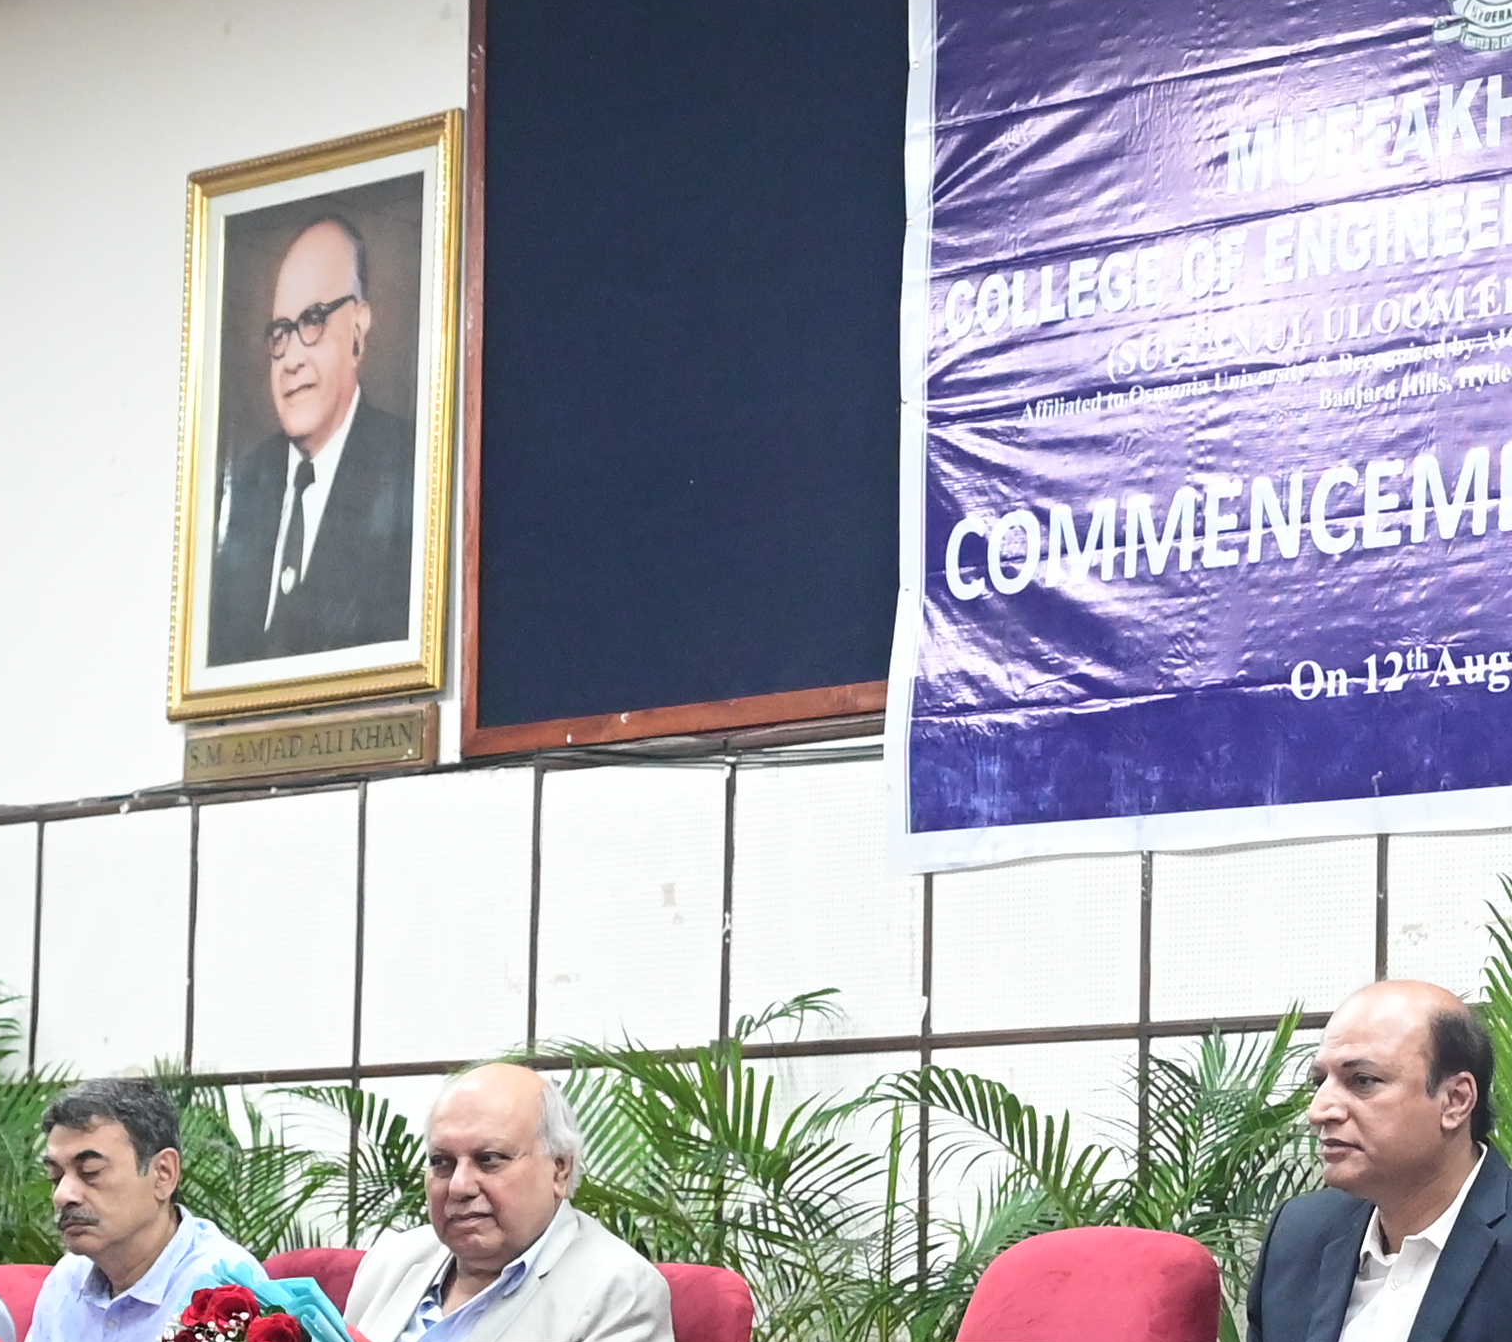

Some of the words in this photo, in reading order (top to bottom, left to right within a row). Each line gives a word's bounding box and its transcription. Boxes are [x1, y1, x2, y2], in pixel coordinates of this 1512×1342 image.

[944, 245, 1164, 340] COLLEGE
[1181, 228, 1247, 299] OF
[1265, 310, 1313, 352] UL
[1321, 286, 1466, 343] ULOOM
[1020, 390, 1102, 423] Affiliated
[1128, 376, 1208, 406] Osmania
[1213, 362, 1308, 394] University
[1313, 355, 1331, 377] &
[1450, 335, 1474, 360] by
[1318, 382, 1398, 410] Banjara
[1402, 372, 1453, 402] Hills,
[1289, 660, 1350, 701] On
[1362, 646, 1430, 697] 12th
[233, 734, 303, 769] AMJAD
[309, 729, 343, 757] ALI
[350, 721, 414, 752] KHAN
